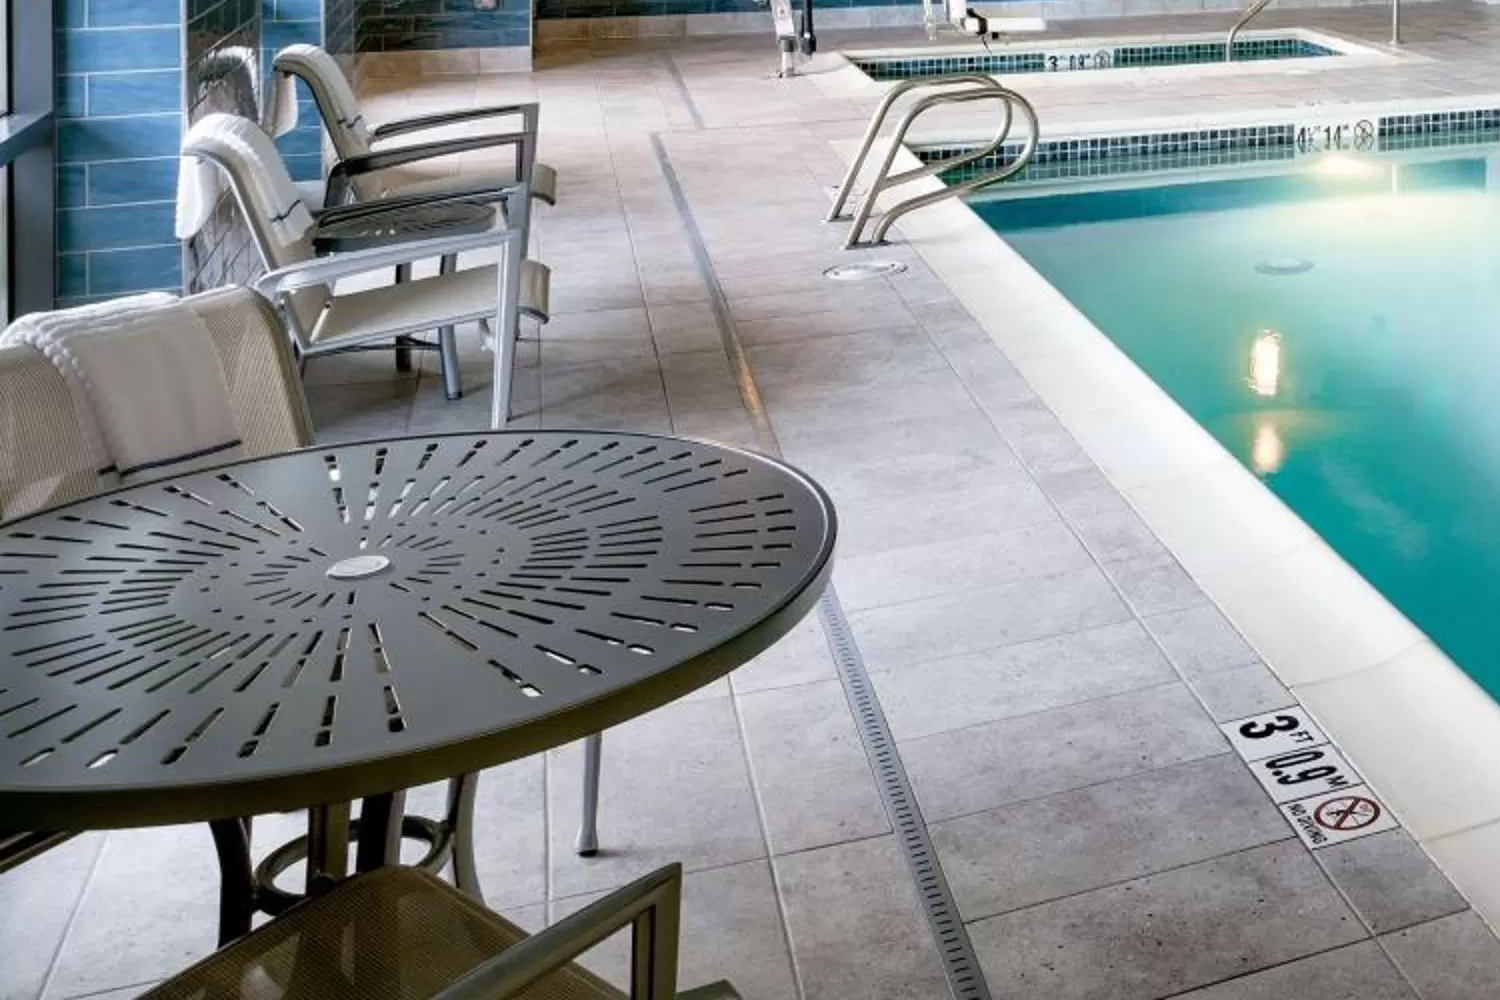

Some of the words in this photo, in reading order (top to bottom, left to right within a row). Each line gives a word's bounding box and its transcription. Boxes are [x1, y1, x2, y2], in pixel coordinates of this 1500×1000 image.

[1239, 715, 1299, 739] 3
[1290, 730, 1315, 743] FT
[1265, 750, 1338, 785] 0.9
[1326, 775, 1350, 788] M
[1287, 803, 1306, 816] NO
[1297, 815, 1328, 844] DIVING
